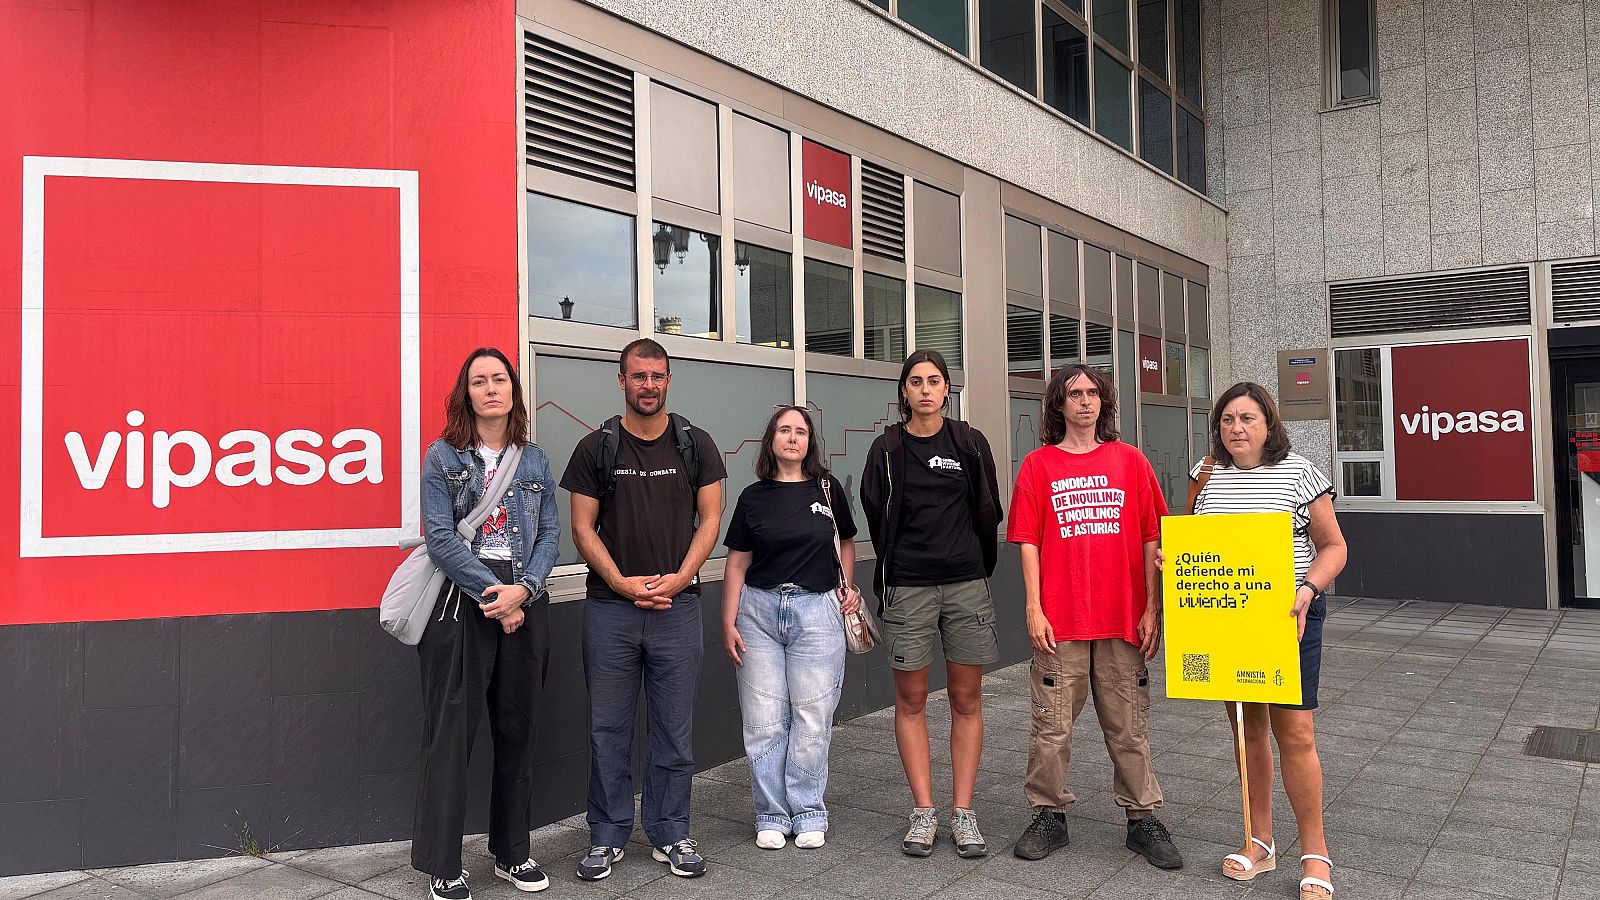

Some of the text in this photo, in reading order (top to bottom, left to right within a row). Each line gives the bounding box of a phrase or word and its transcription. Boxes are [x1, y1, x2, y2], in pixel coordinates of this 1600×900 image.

[806, 179, 847, 208] vipasa
[1142, 356, 1158, 371] vipasa
[1400, 405, 1525, 441] vipasa
[64, 410, 384, 509] vipasa
[1051, 475, 1108, 493] SINDICATO
[1055, 491, 1123, 508] DE INQUILINAS
[1057, 507, 1120, 525] E INQUILINOS
[1060, 522, 1120, 539] DE ASTURIAS
[1175, 552, 1221, 565] ¿Quién
[1175, 565, 1255, 577] defiende mi
[1176, 579, 1272, 591] derecho a una
[1236, 669, 1266, 679] AMNISTÍA
